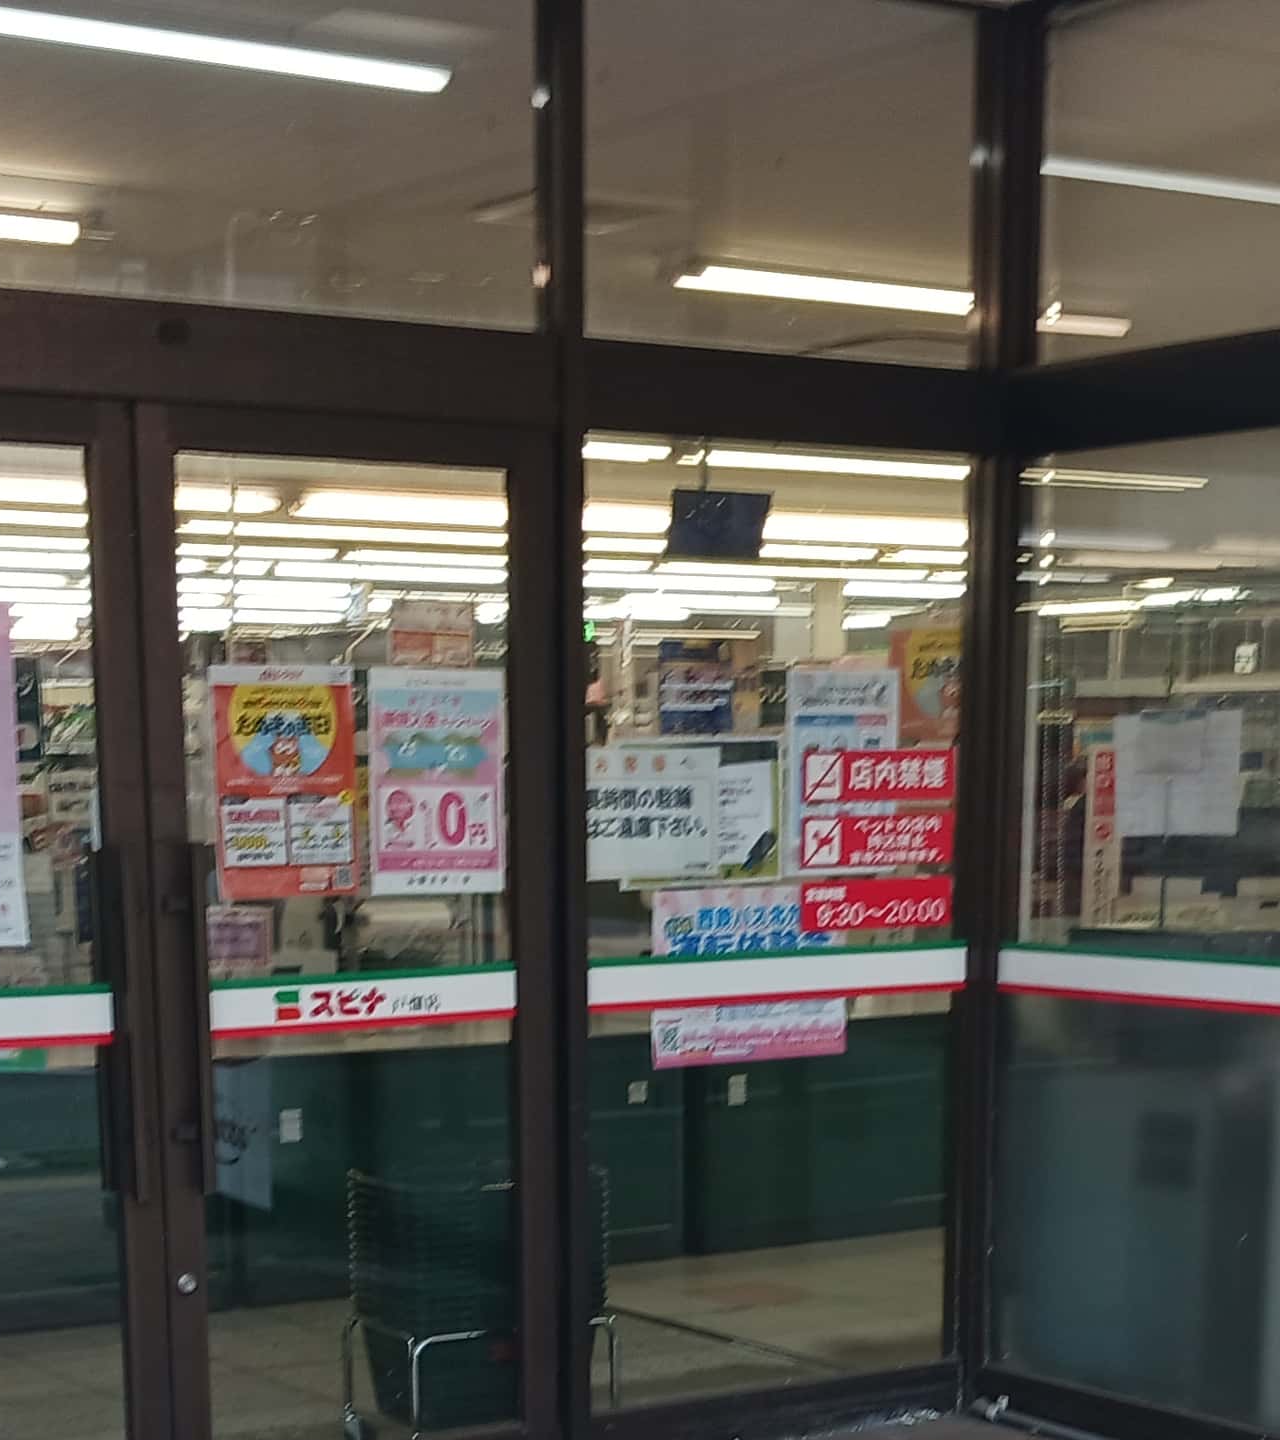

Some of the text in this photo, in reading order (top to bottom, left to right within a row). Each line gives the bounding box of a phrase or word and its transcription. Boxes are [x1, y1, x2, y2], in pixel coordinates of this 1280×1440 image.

[848, 756, 948, 791] 店内禁煙
[310, 986, 386, 1018] スピナ
